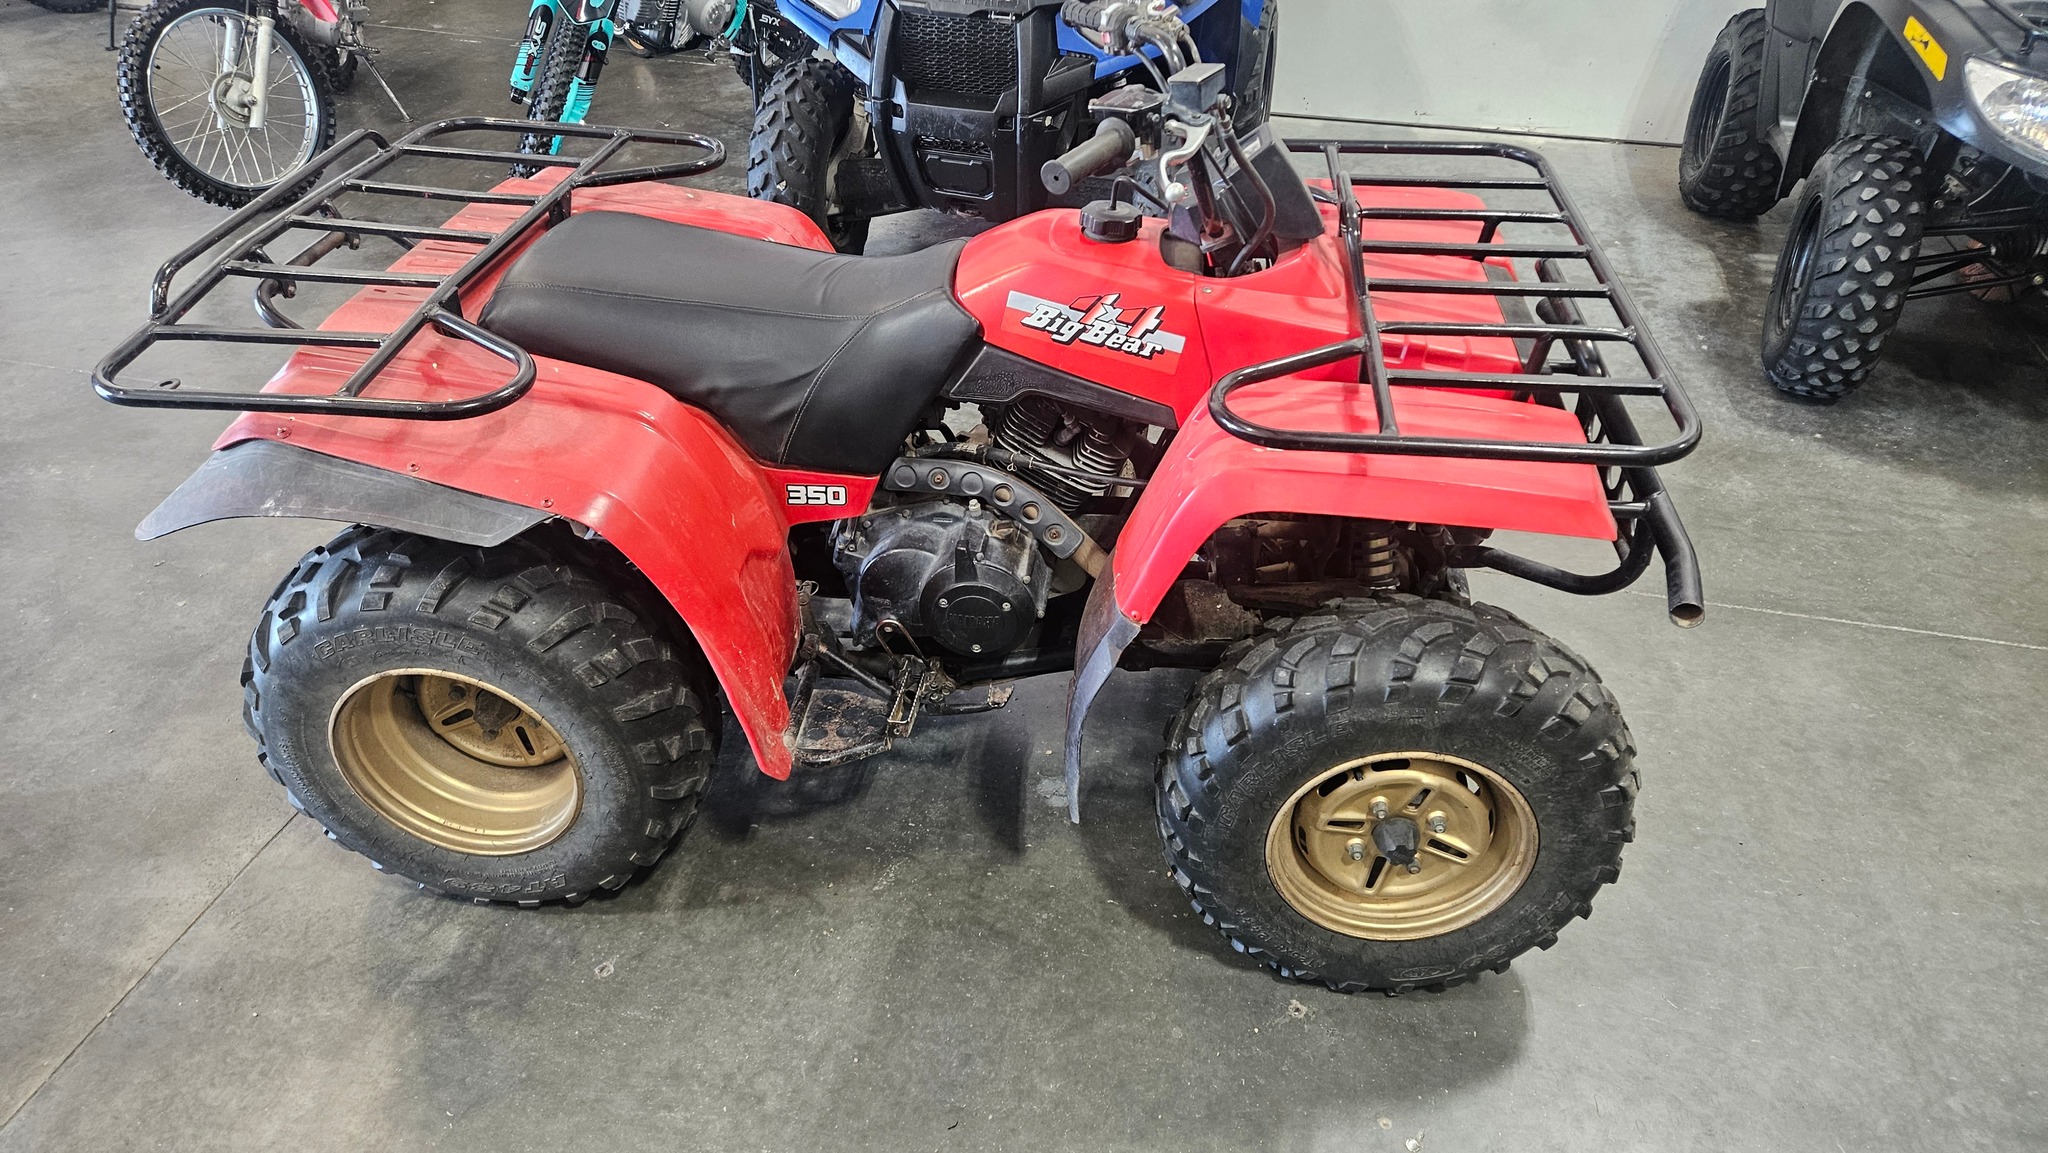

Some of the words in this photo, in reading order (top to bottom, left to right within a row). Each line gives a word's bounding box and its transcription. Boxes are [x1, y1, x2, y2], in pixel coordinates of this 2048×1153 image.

[527, 15, 547, 57] SYX
[759, 13, 781, 27] SYX
[786, 484, 847, 506] 350
[312, 625, 484, 661] CARLISLE
[1217, 718, 1351, 828] CARLISLE
